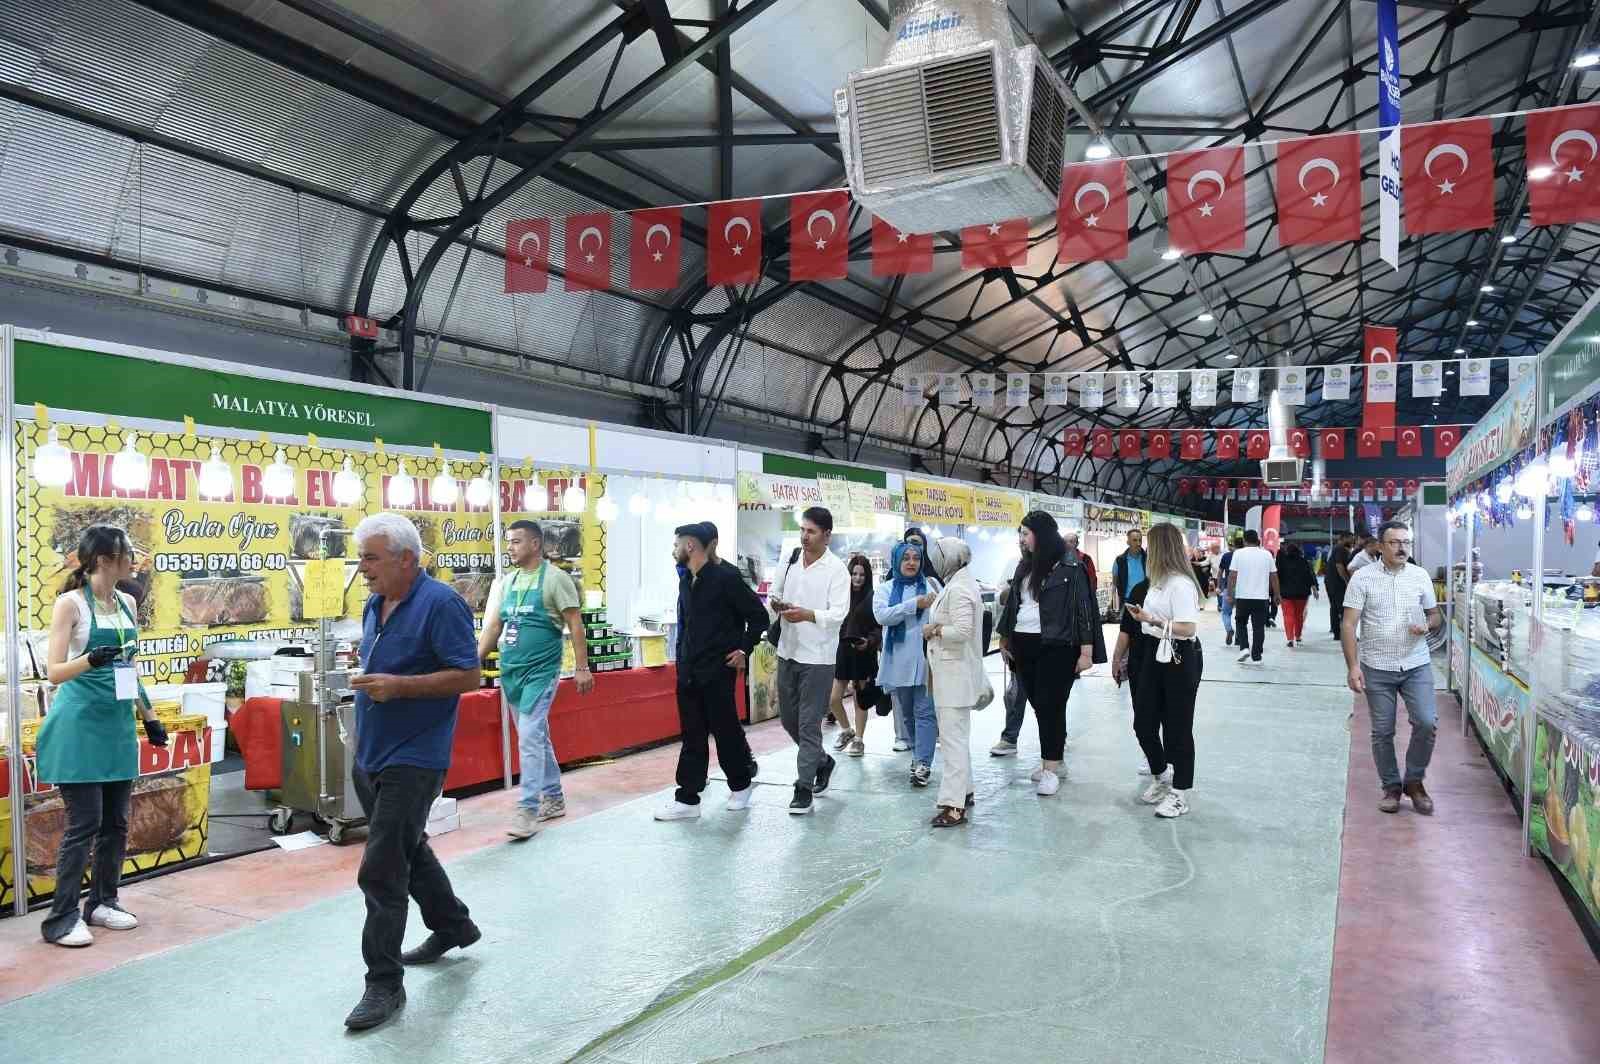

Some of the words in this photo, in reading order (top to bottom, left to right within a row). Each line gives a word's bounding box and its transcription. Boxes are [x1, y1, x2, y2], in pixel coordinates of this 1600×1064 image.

[212, 392, 299, 418] MALATYA
[303, 402, 376, 427] YÖRESEL
[772, 482, 799, 503] HATAY
[228, 511, 280, 551] Oğuz
[155, 552, 204, 571] 0535
[206, 553, 239, 571] 674
[240, 553, 262, 571] 66
[264, 553, 287, 571] 40
[436, 552, 467, 569] 0535
[469, 553, 492, 569] 674
